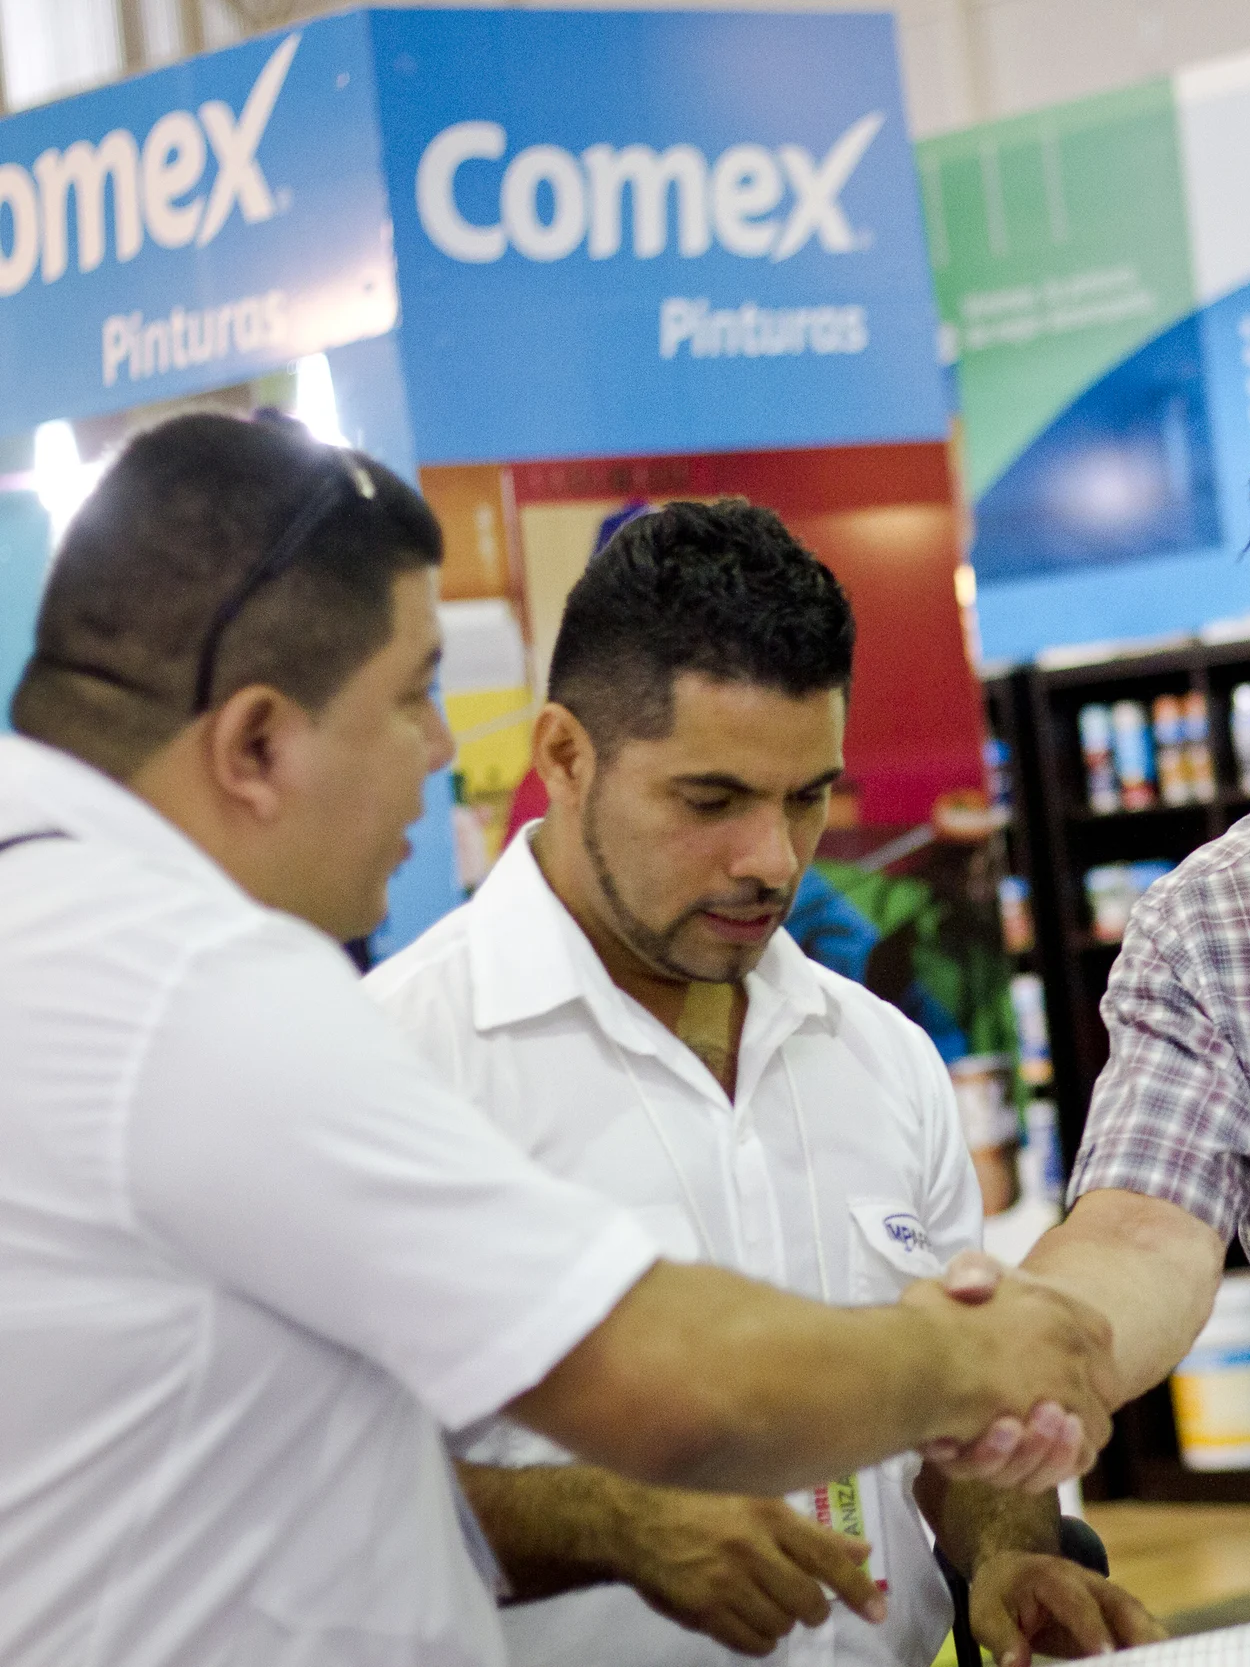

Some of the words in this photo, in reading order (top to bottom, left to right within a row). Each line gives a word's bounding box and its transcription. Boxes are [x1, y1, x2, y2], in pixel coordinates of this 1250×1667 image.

[0, 33, 302, 297] omex
[416, 111, 886, 264] Comex
[102, 290, 287, 387] Pinturas
[659, 297, 868, 360] Pinturas
[838, 1475, 861, 1535] ANIZA
